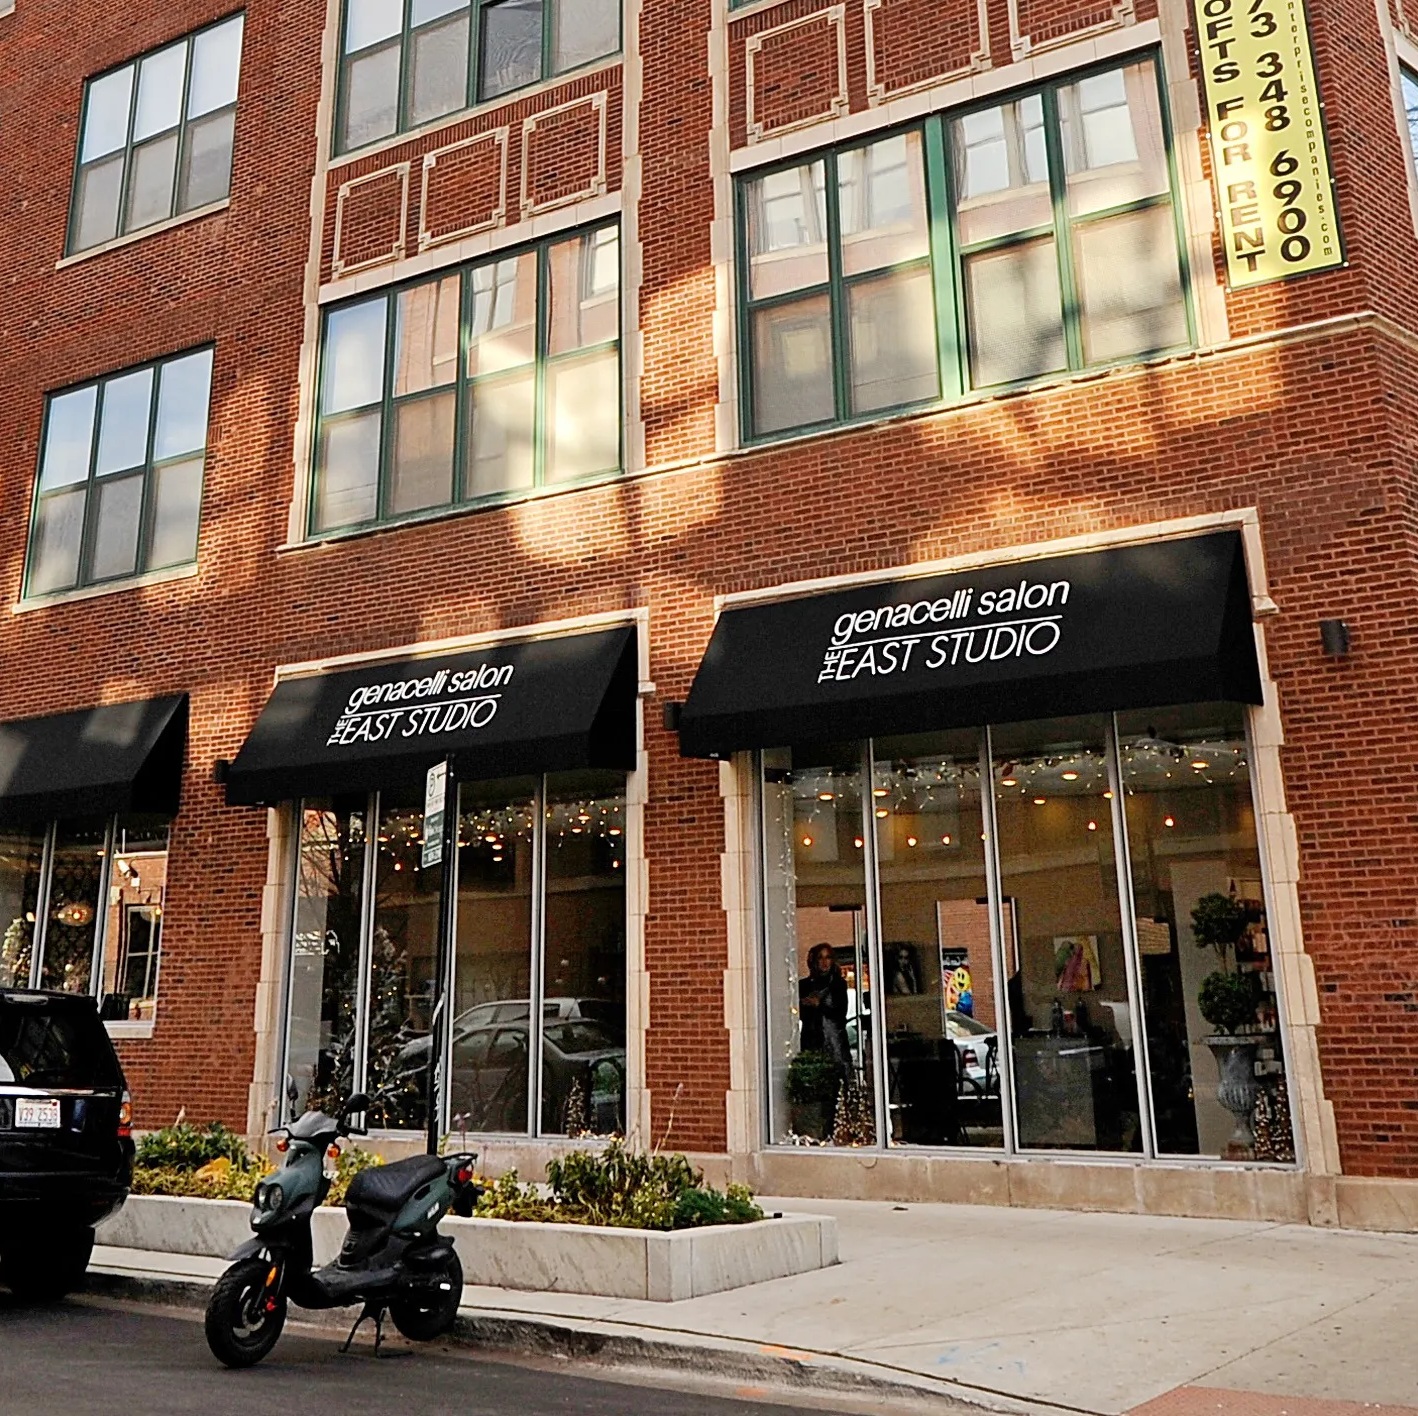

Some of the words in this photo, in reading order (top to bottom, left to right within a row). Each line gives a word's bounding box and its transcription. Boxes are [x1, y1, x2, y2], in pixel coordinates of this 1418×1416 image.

[1255, 51, 1291, 133] 348
[1216, 95, 1253, 166] FOR
[1227, 179, 1266, 273] RENT
[1269, 148, 1311, 263] 6900
[831, 588, 973, 646] genacelli
[977, 580, 1070, 615] salon
[817, 650, 841, 684] THE
[835, 639, 921, 681] EAST
[925, 621, 1061, 668] STUDIO
[345, 668, 451, 715] genacelli
[447, 663, 515, 694] salon
[326, 718, 350, 746] THE
[339, 711, 405, 745] EAST
[401, 698, 498, 737] STUDIO
